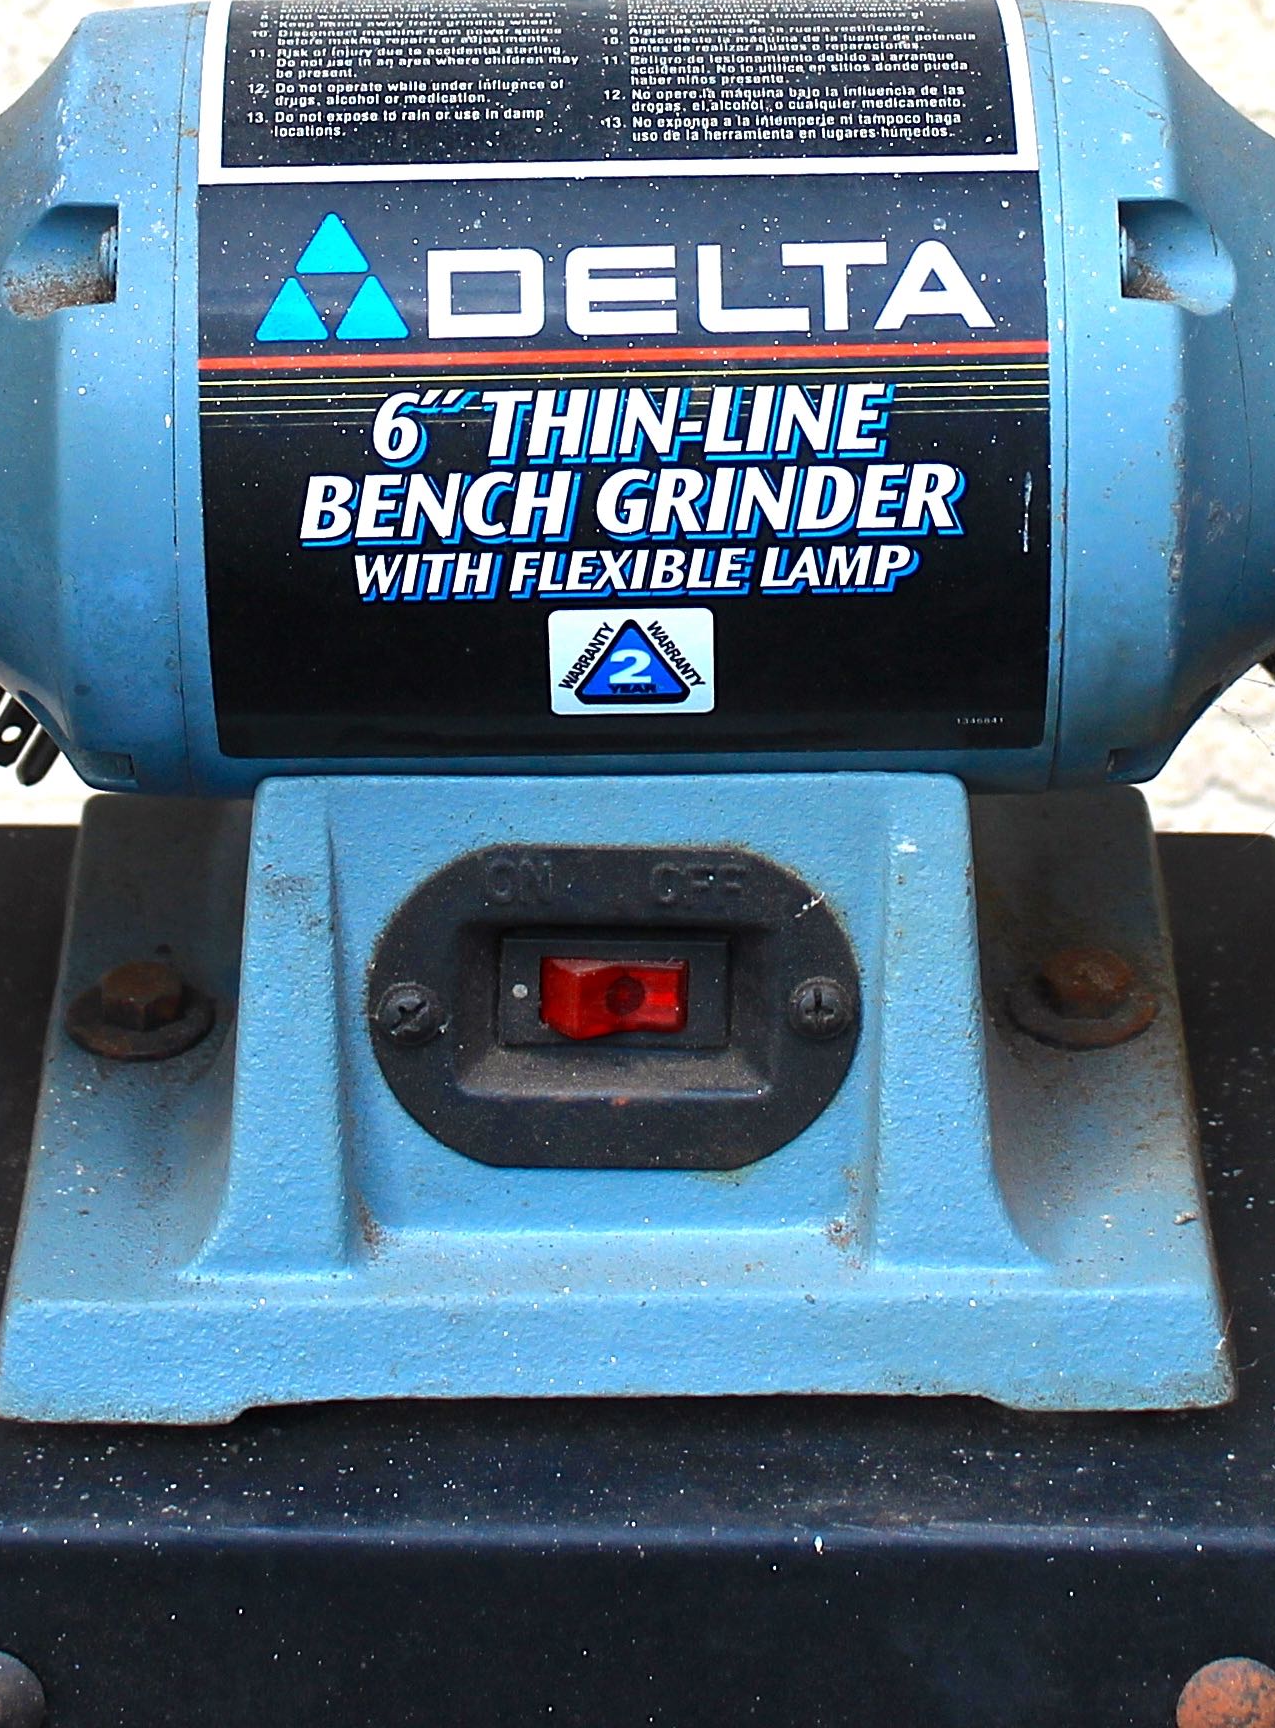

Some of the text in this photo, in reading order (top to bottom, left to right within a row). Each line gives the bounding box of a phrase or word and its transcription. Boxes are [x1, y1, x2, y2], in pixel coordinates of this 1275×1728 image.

[467, 28, 509, 37] power
[249, 49, 271, 57] 11.
[277, 49, 308, 57] Risk
[313, 48, 326, 57] of
[331, 47, 372, 57] injury
[377, 48, 403, 56] due
[409, 47, 422, 56] to
[426, 46, 501, 55] accidental
[277, 56, 578, 67] Do not use in an area where children may
[602, 53, 954, 65] 11. Peligro de lesionamiento debido al arranque
[276, 68, 357, 79] be present.
[630, 61, 967, 74] accidental. No lo utilice en sitios donde pueda
[631, 76, 672, 85] haber
[721, 74, 789, 85] presente.
[249, 79, 564, 94] 12. Do not operate while under influence of
[604, 85, 964, 101] 12. No opere la máquina bajo la influencia de las
[326, 94, 379, 105] alcohol
[385, 95, 399, 103] or
[404, 93, 490, 104] medication.
[692, 101, 705, 110] el
[775, 101, 783, 110] o
[789, 99, 856, 111] cualquier
[862, 98, 966, 108] medicamento.
[248, 109, 544, 123] 13. Do not expose to rain or use in damp
[605, 113, 961, 129] 13. No exponga a la intemperie ni tampoco haga
[275, 126, 346, 137] locations.
[633, 132, 657, 141] uso
[664, 131, 680, 141] de
[686, 130, 698, 140] la
[705, 128, 793, 140] herramienta
[799, 129, 816, 139] en
[822, 128, 876, 140] lugares
[427, 240, 995, 339] DELTA
[474, 383, 895, 463] THIN-LINE
[300, 465, 965, 545] BENCH GRINDER
[355, 545, 919, 599] WITH FLEXIBLE LAMP
[558, 622, 614, 689] WARRANTY
[647, 621, 706, 686] WARRANTY
[609, 649, 651, 683] 2
[608, 683, 656, 694] YEAR
